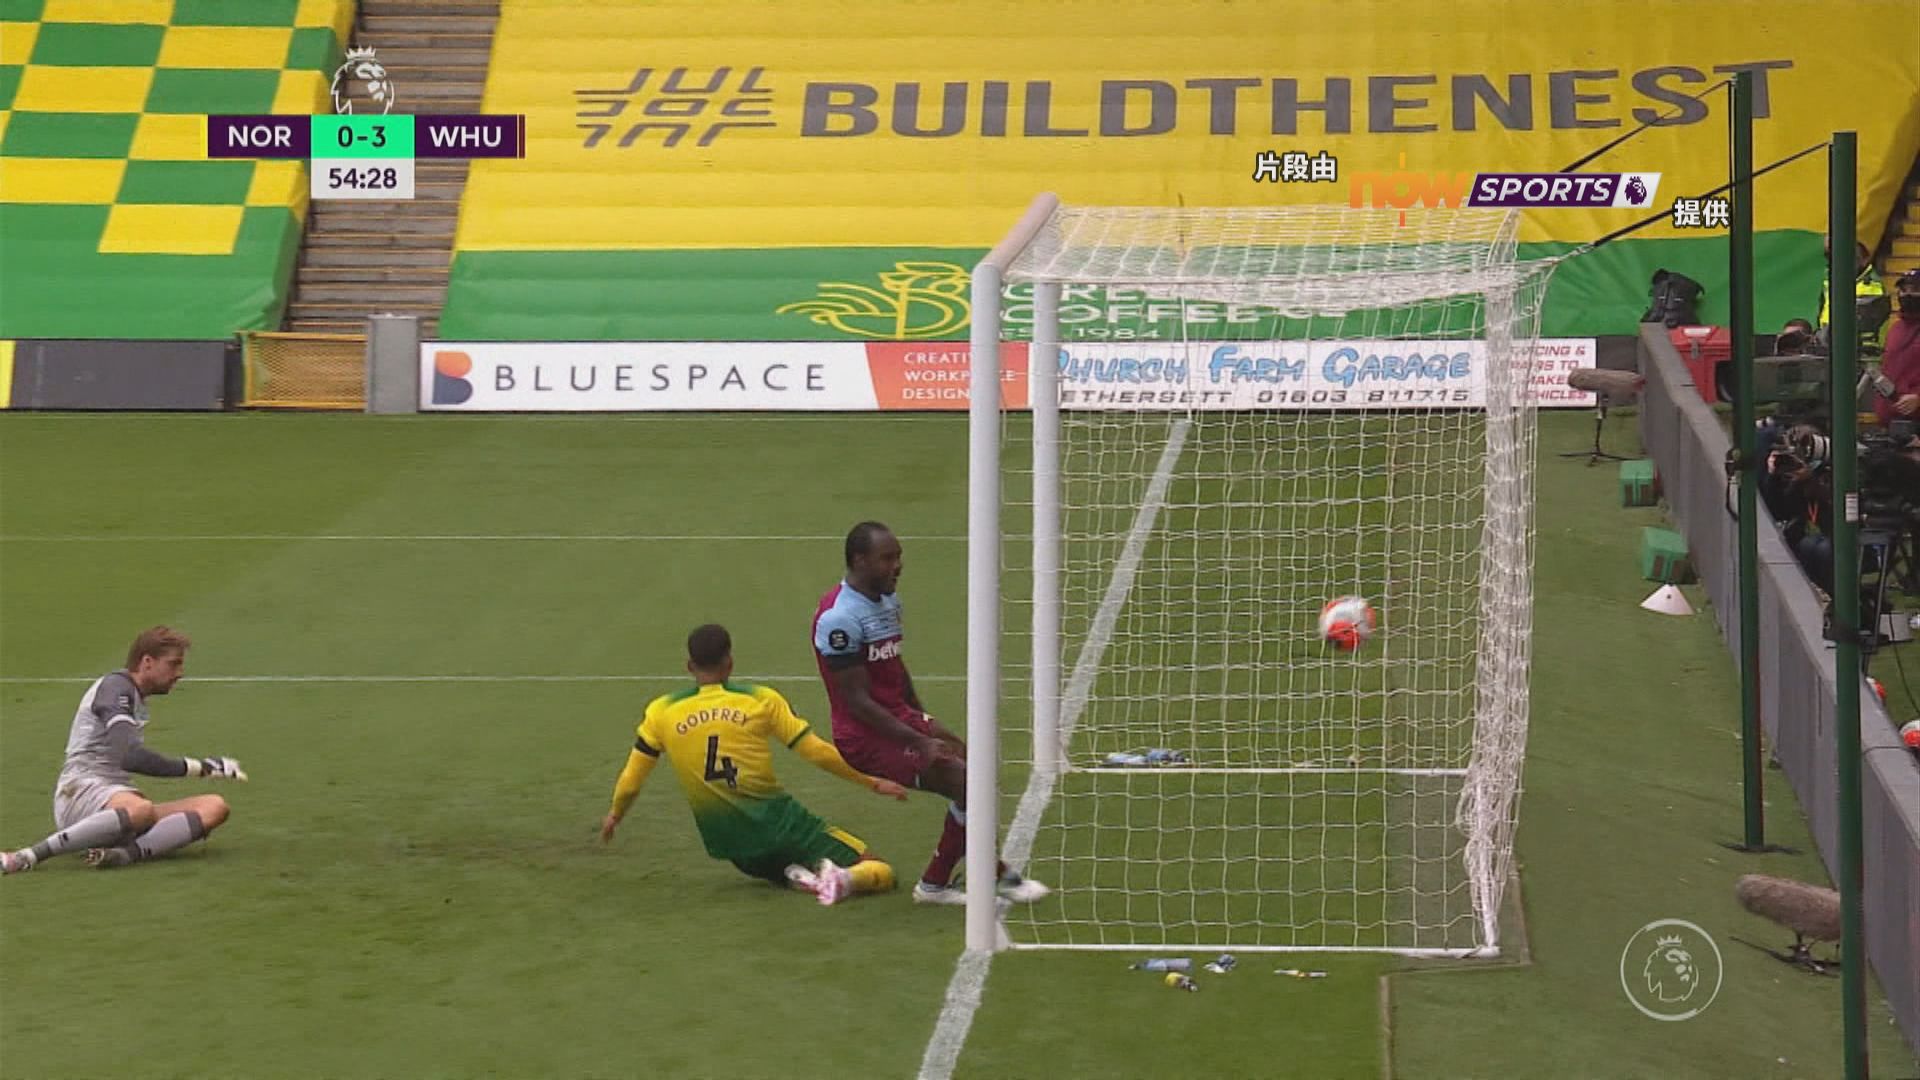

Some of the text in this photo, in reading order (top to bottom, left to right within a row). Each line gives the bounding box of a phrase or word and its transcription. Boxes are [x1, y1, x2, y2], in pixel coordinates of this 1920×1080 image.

[1072, 327, 1161, 340] 1984
[495, 364, 826, 392] BLUESPACE
[1257, 390, 1347, 403] 01603
[1368, 390, 1468, 402] 811715
[676, 707, 750, 736] GODFREY
[703, 735, 739, 788] 4
